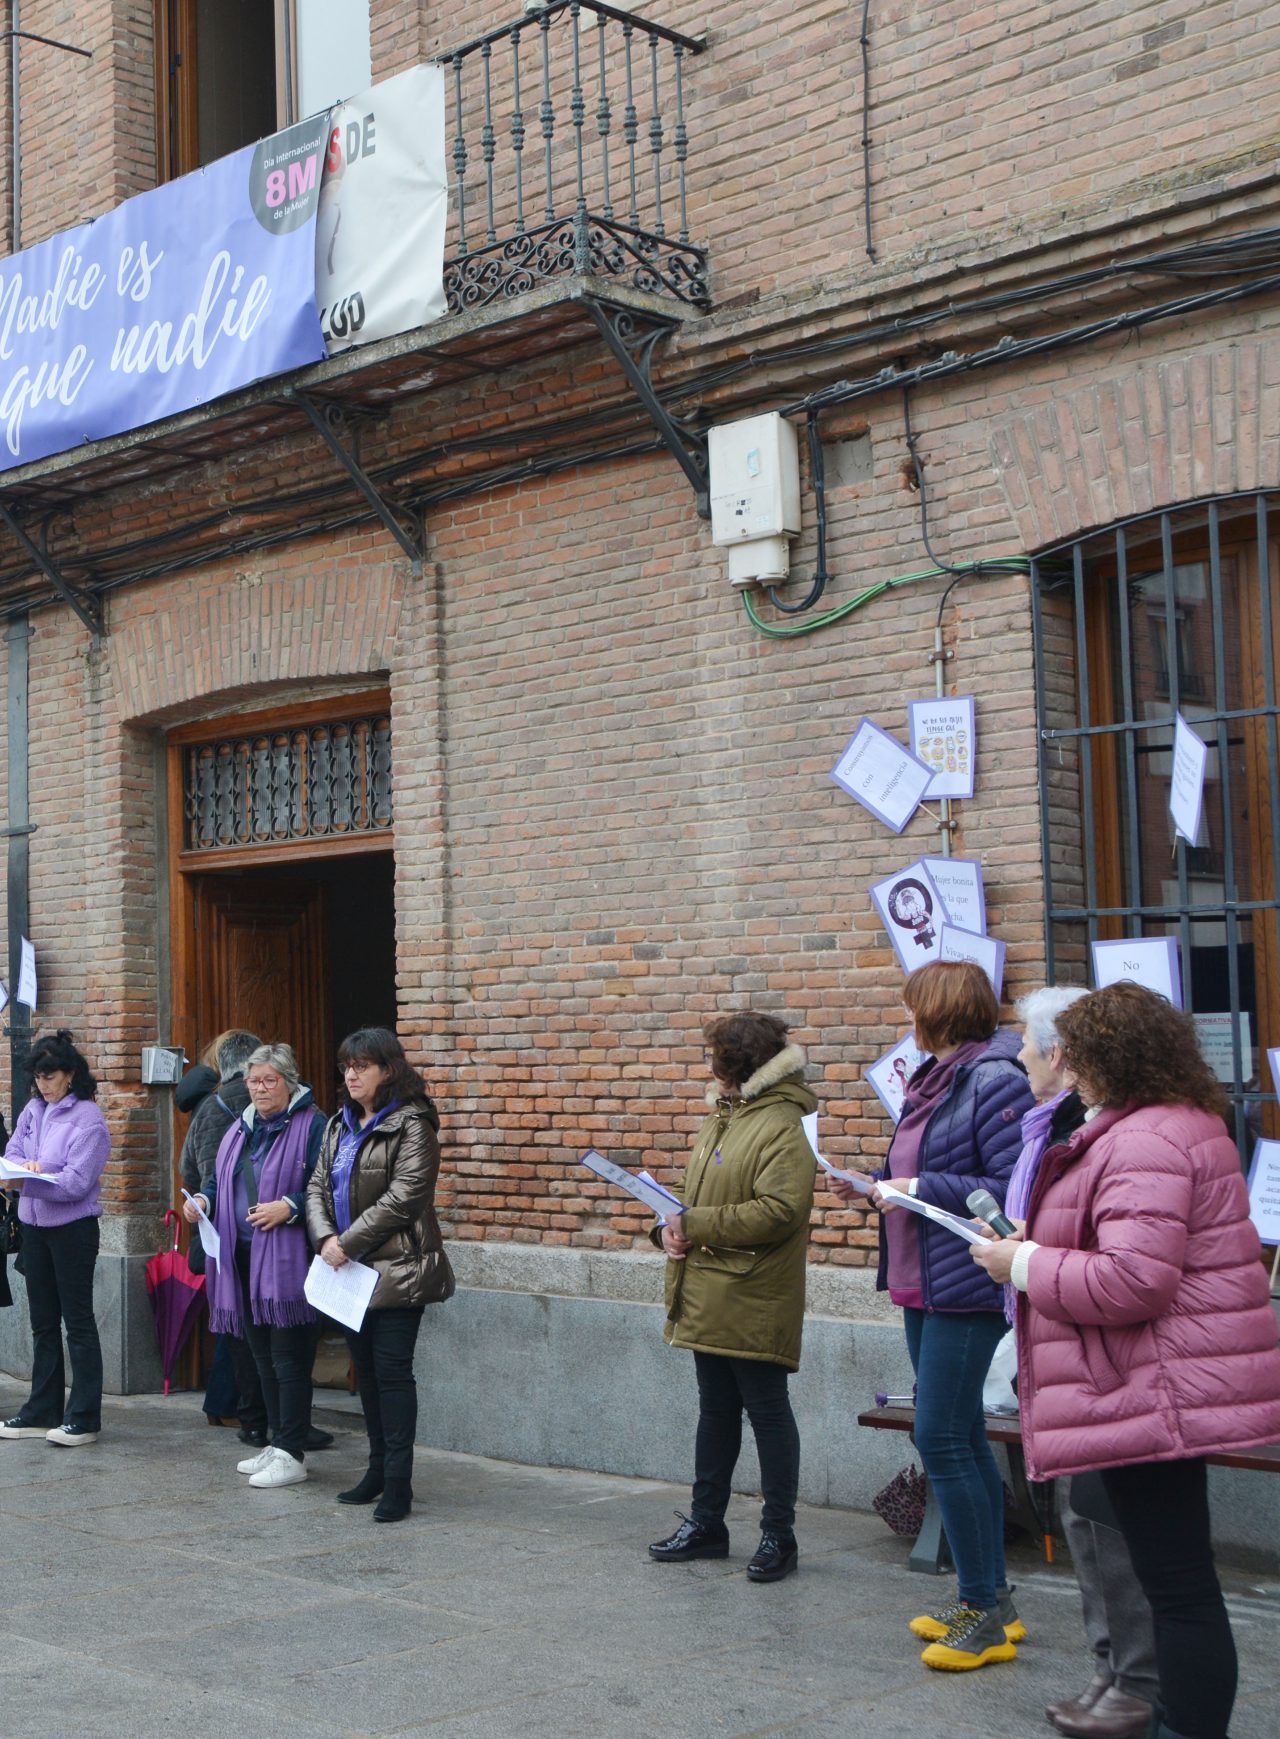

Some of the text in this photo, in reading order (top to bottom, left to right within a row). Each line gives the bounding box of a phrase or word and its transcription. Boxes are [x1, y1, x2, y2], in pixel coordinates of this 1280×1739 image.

[276, 136, 321, 164] Internacional
[346, 112, 376, 166] DE
[265, 154, 317, 208] 8M
[273, 196, 310, 220] de la Mujer
[117, 240, 164, 301] es
[0, 344, 95, 456] que
[110, 250, 272, 373] nadie
[844, 735, 873, 776] Construyamos
[862, 773, 874, 788] con
[879, 761, 908, 802] inteligencia
[952, 875, 974, 887] bonita
[948, 894, 955, 903] la
[955, 896, 969, 905] que
[1123, 961, 1140, 972] No
